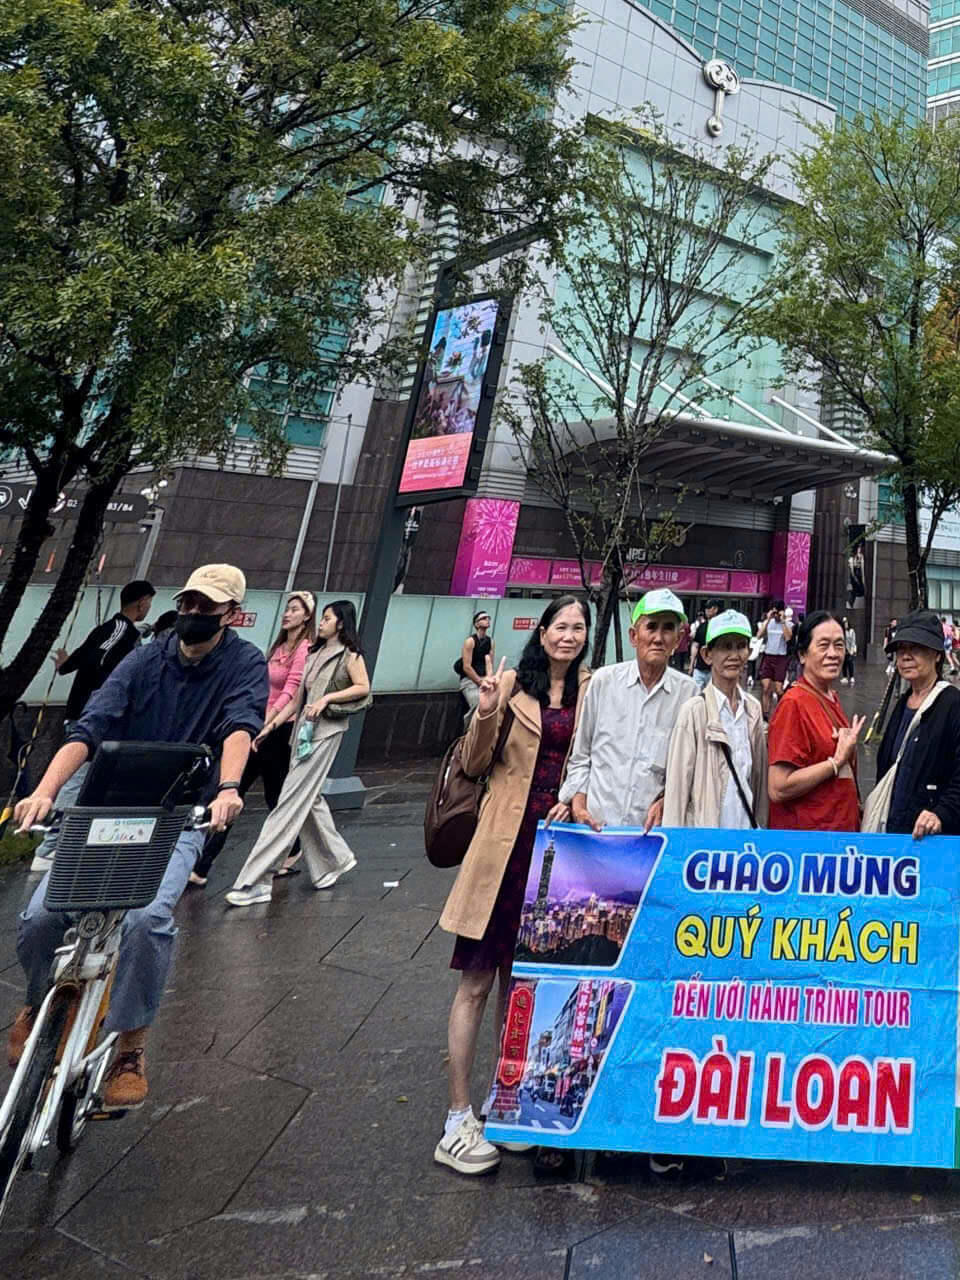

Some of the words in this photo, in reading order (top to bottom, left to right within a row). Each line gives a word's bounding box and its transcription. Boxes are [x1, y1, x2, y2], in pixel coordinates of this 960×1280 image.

[684, 843, 792, 894] CHÀO
[800, 846, 920, 897] MỪNG
[675, 904, 763, 958] QUÝ
[771, 905, 919, 964] KHÁCH
[672, 973, 710, 1018] ĐẾN
[714, 977, 746, 1019] VỚI
[748, 980, 800, 1022] HÀNH
[804, 982, 859, 1025] TRÌNH
[864, 990, 911, 1026] TOUR
[658, 1039, 752, 1121] ĐÀI
[764, 1056, 912, 1129] LOAN
